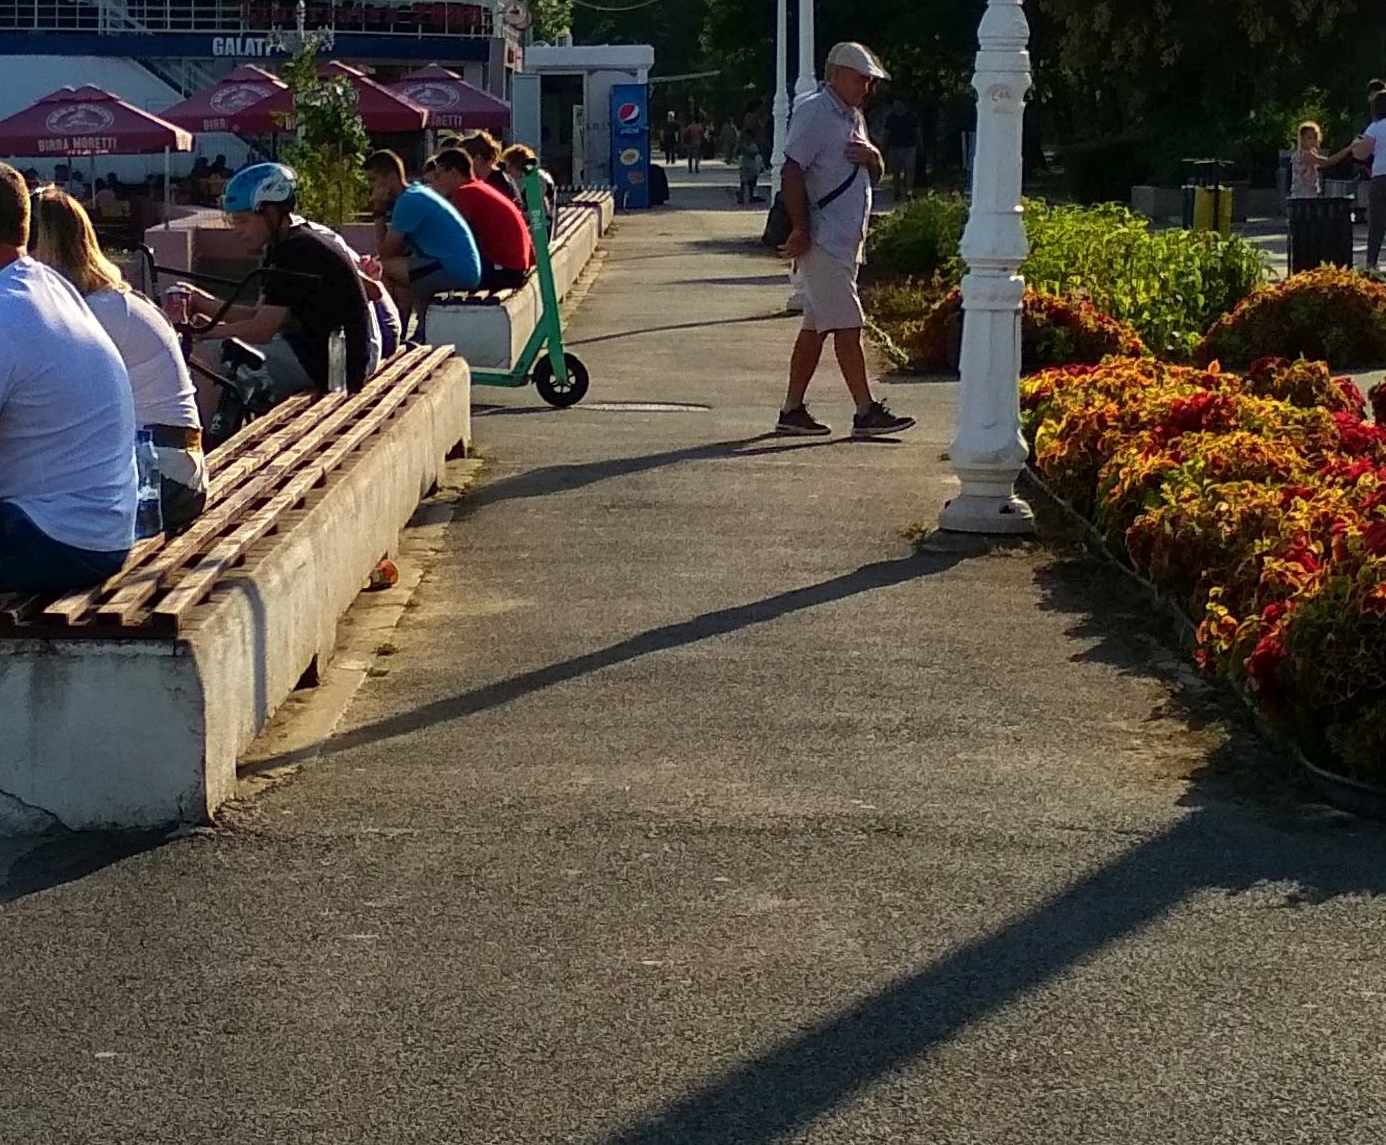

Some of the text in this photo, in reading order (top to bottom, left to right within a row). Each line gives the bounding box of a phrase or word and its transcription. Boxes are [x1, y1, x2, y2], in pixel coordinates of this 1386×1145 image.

[203, 118, 229, 131] BIRR
[38, 136, 117, 152] BIRRA MORETTI
